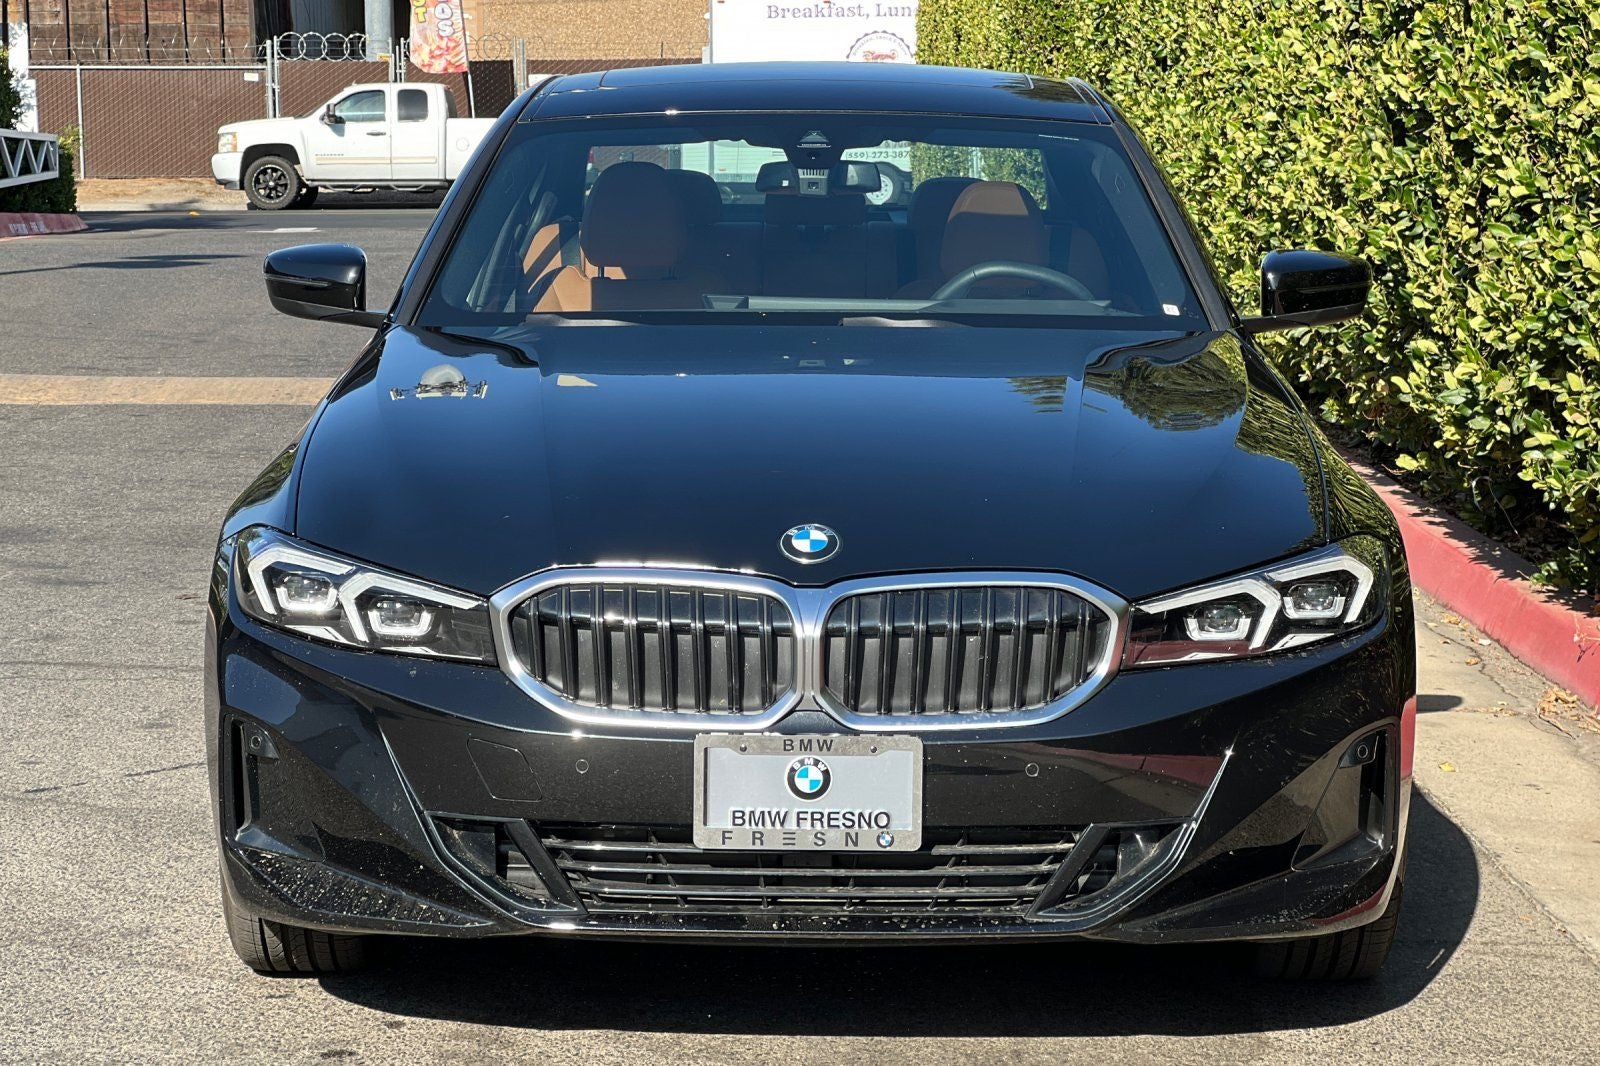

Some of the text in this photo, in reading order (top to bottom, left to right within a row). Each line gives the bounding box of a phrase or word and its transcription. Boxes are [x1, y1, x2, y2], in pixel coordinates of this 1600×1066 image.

[434, 0, 455, 37] OS
[767, 3, 914, 19] Breakfast, Lun
[783, 739, 834, 752] BMW
[792, 757, 827, 771] BMW
[731, 810, 891, 829] BMW FRESNO
